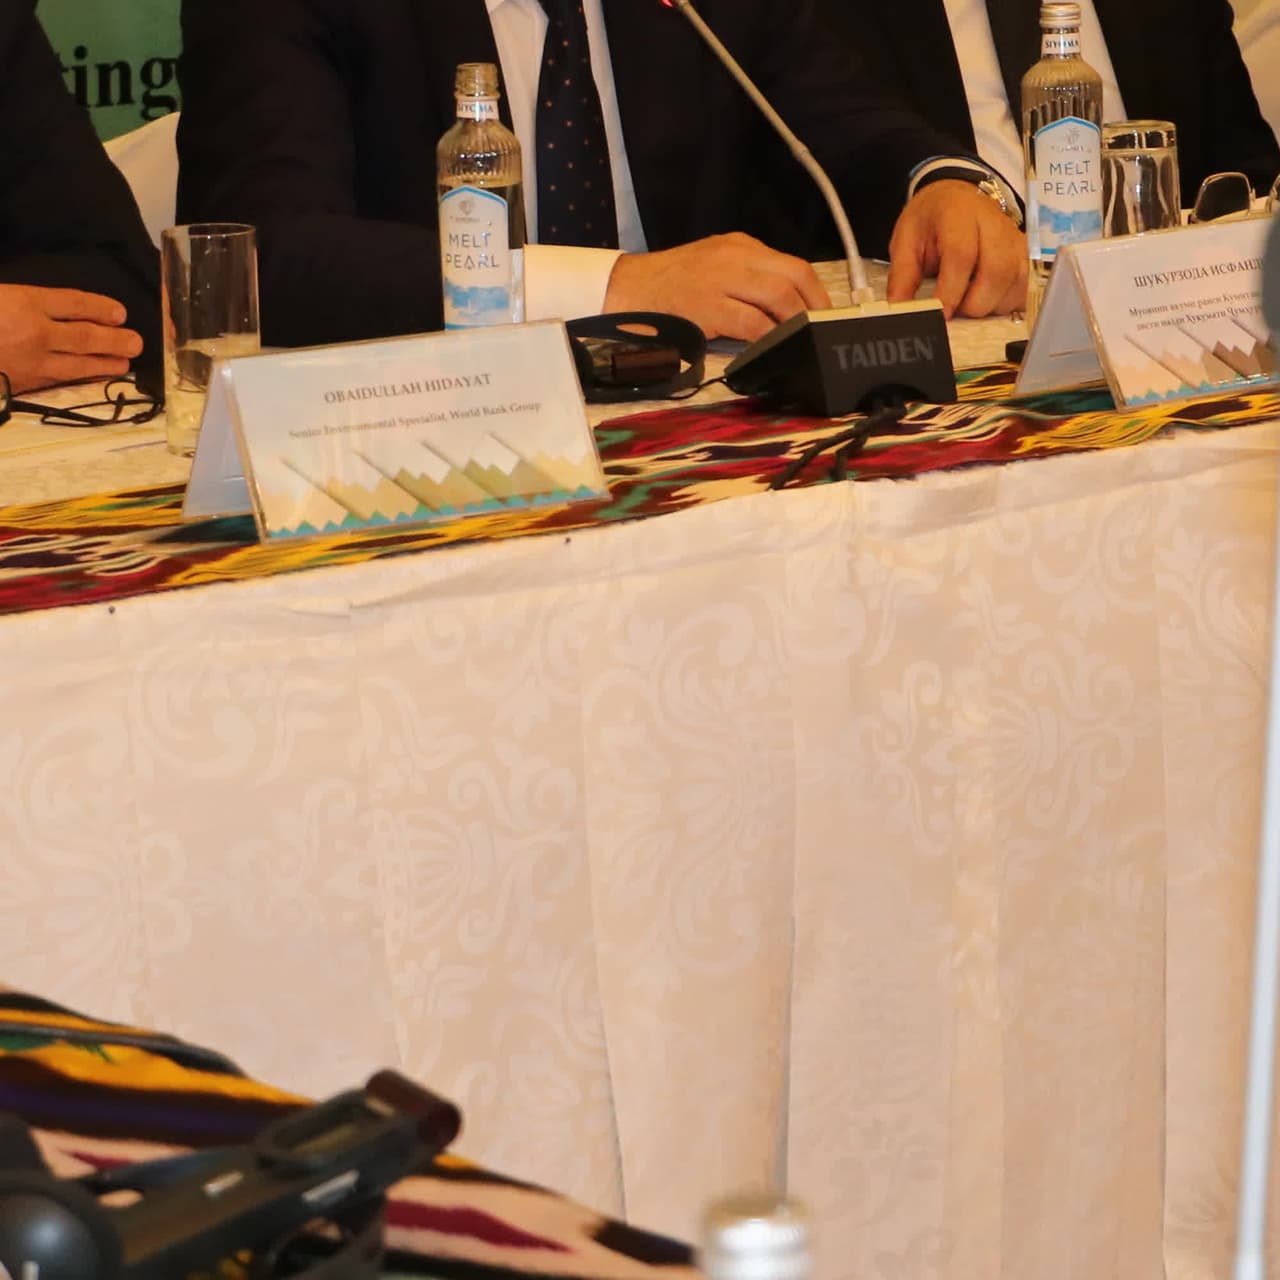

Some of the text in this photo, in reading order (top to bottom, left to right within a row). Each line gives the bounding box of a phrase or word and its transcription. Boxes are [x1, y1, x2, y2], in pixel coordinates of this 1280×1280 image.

[1049, 160, 1091, 176] MELT
[1043, 180, 1097, 197] PEARL
[448, 231, 491, 248] MELT
[445, 254, 500, 270] PEARL
[1133, 267, 1208, 288] ШУКУРЗОДА
[832, 336, 935, 370] TAIDEN
[323, 372, 492, 404] OBAIDULLAH HIDAYAT
